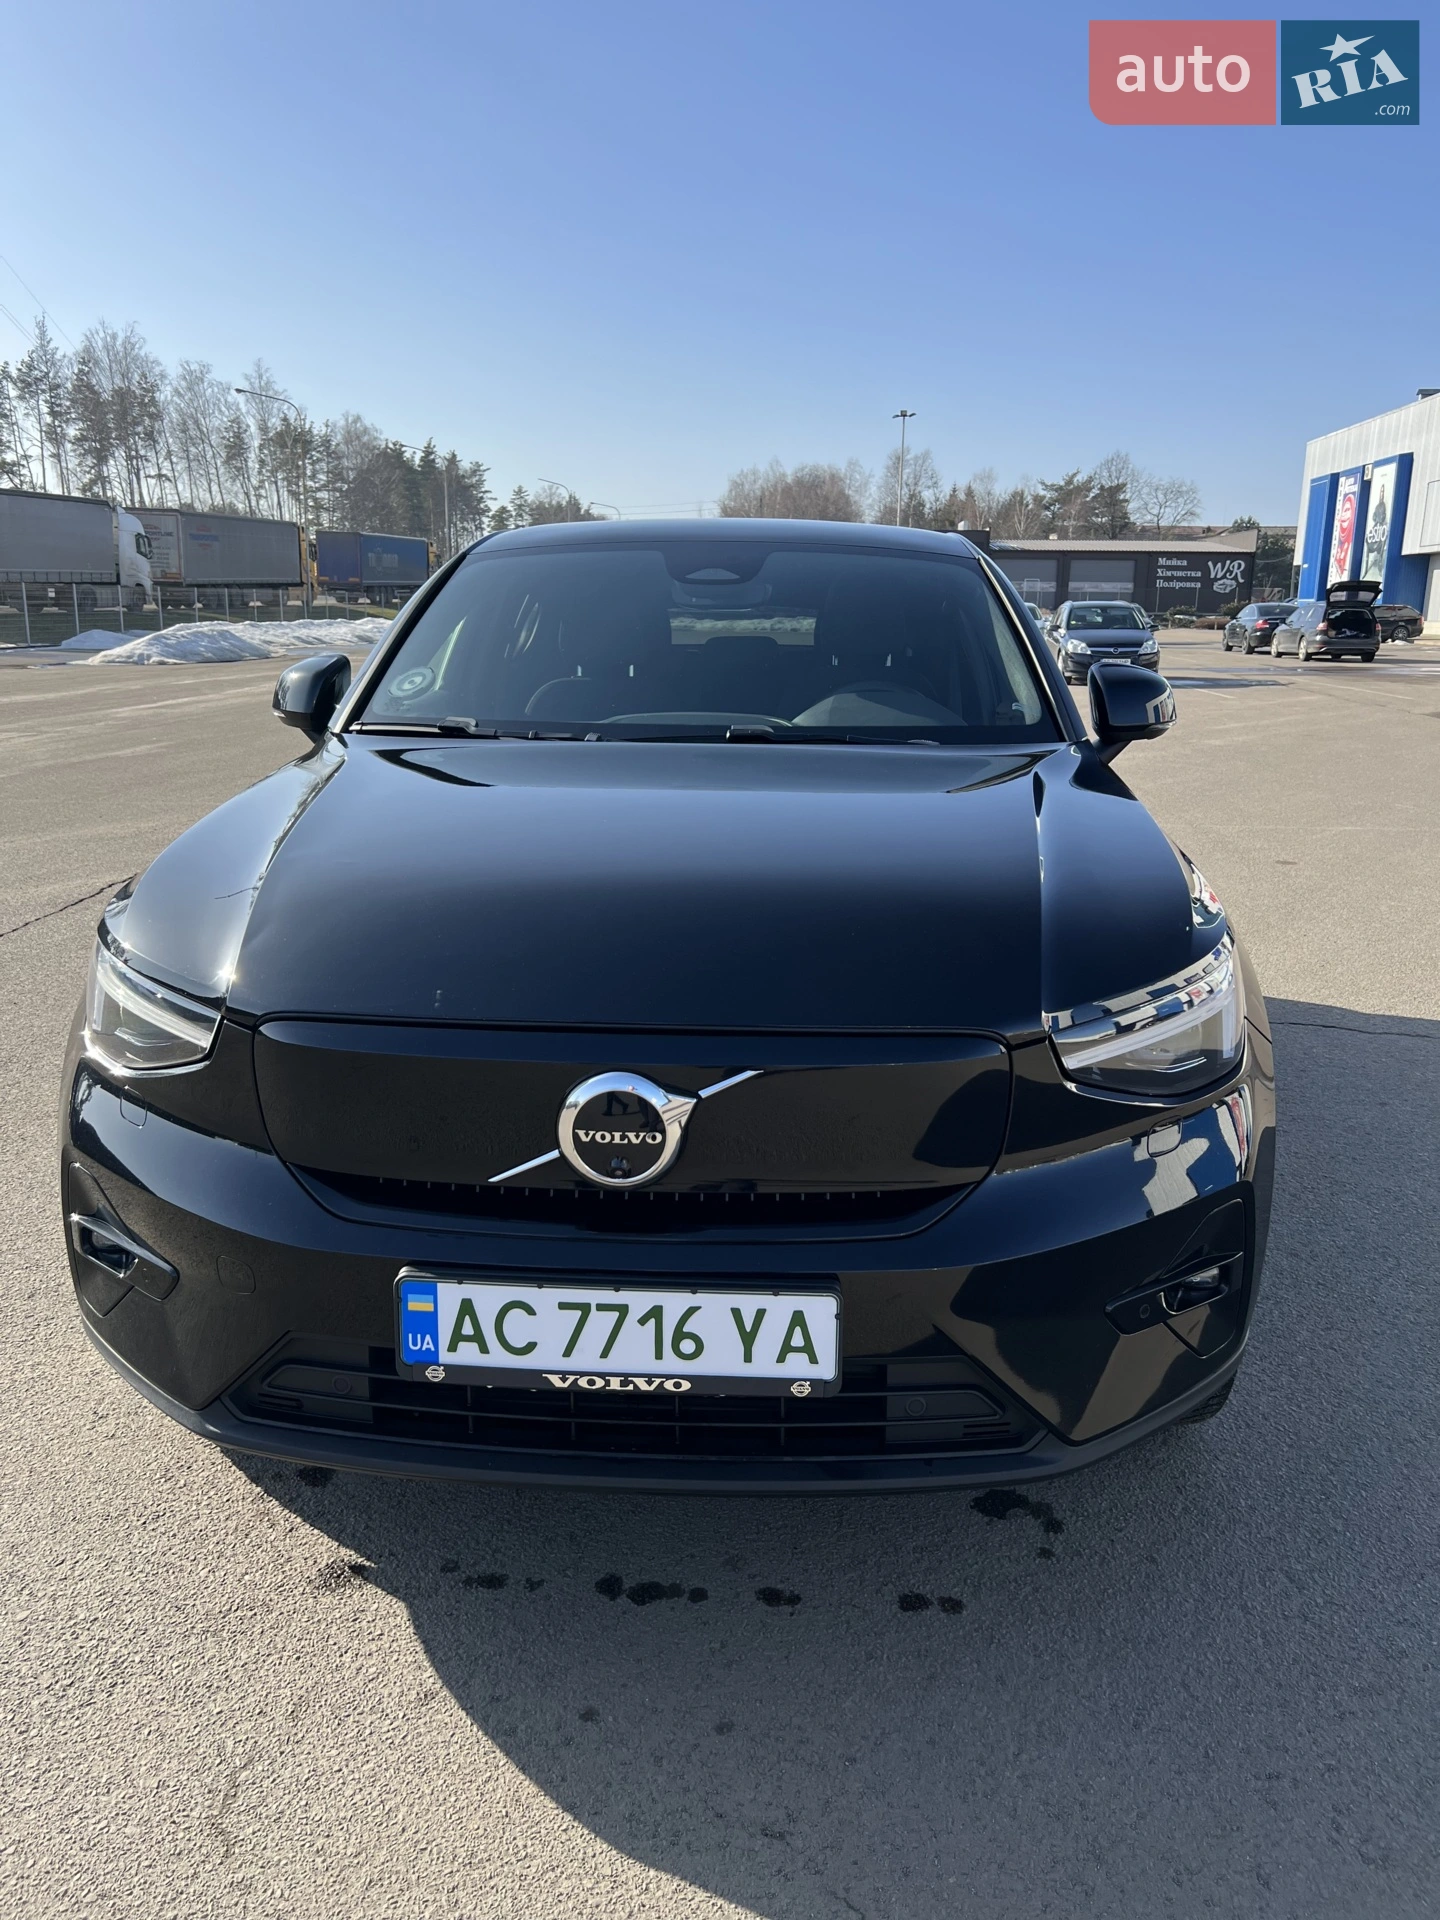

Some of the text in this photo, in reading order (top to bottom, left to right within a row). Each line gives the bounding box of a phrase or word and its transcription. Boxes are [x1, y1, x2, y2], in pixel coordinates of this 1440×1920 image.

[1367, 524, 1388, 543] estro
[1158, 557, 1188, 566] Мийка
[1156, 568, 1202, 577] Хімчистка
[1207, 560, 1246, 583] WR
[1156, 579, 1202, 590] Поліровка
[574, 1129, 663, 1144] VOLVO
[446, 1298, 820, 1365] AC 7716 YA
[408, 1333, 435, 1352] UA
[542, 1373, 692, 1392] VOLVO
